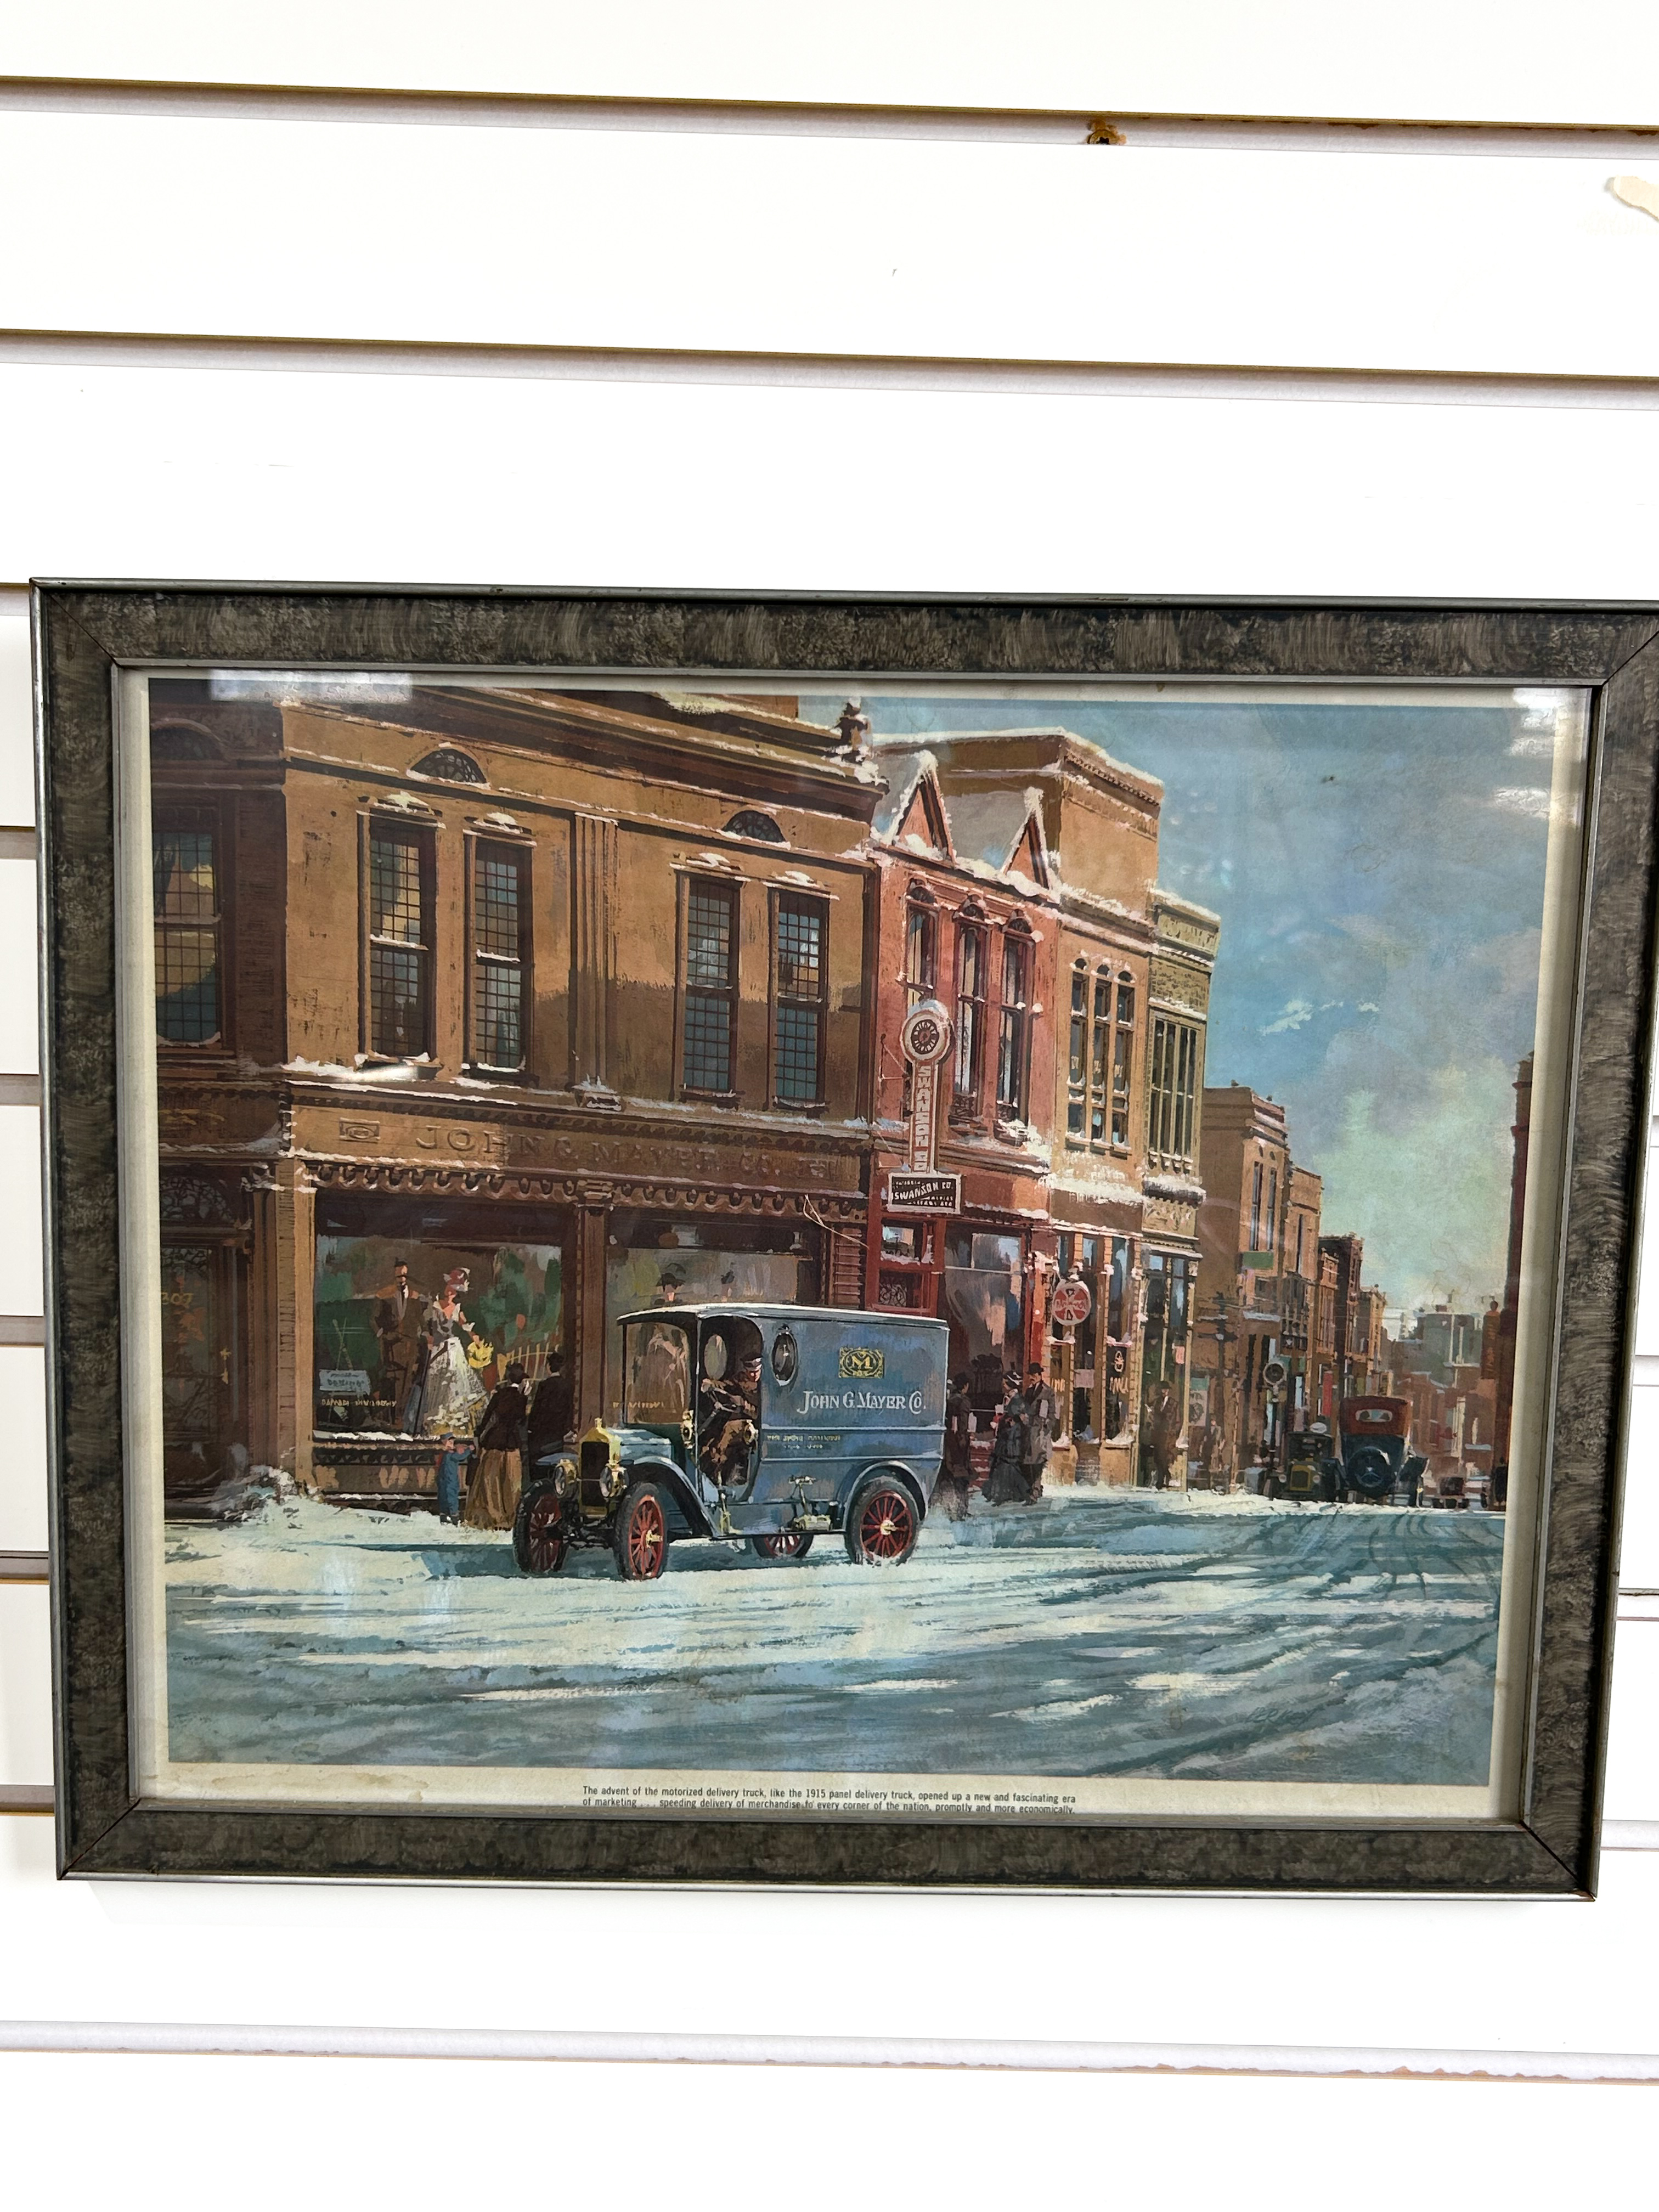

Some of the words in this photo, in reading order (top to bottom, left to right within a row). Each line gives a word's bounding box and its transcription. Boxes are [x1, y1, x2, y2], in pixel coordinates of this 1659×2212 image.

[415, 1125, 545, 1155] JOHN
[894, 1181, 939, 1200] SWANSON
[583, 1786, 598, 1795] The
[601, 1786, 629, 1795] advent
[633, 1786, 641, 1795] of
[645, 1787, 658, 1796] the
[662, 1787, 703, 1796] motorized
[706, 1788, 740, 1798] delivery
[743, 1788, 767, 1798] truck,
[770, 1788, 785, 1797] like
[789, 1788, 802, 1797] the
[806, 1788, 826, 1798] 1915
[829, 1790, 851, 1799] panel
[855, 1790, 888, 1801] delivery
[891, 1791, 915, 1801] truck,
[918, 1791, 949, 1801] opened
[952, 1793, 962, 1802] up
[994, 1793, 1009, 1801] and
[1013, 1793, 1059, 1804] fascinating
[583, 1797, 591, 1806] of
[595, 1797, 637, 1808] marketing
[659, 1798, 697, 1809] speeding
[700, 1798, 733, 1809] delivery
[736, 1799, 745, 1808] of
[748, 1799, 801, 1809] merchandise
[805, 1799, 814, 1809] to
[817, 1802, 839, 1810] every
[873, 1801, 882, 1810] of
[886, 1802, 900, 1810] the
[935, 1803, 973, 1812] promptly
[975, 1803, 991, 1812] and
[994, 1804, 1015, 1813] more
[1019, 1804, 1075, 1814] economically.
